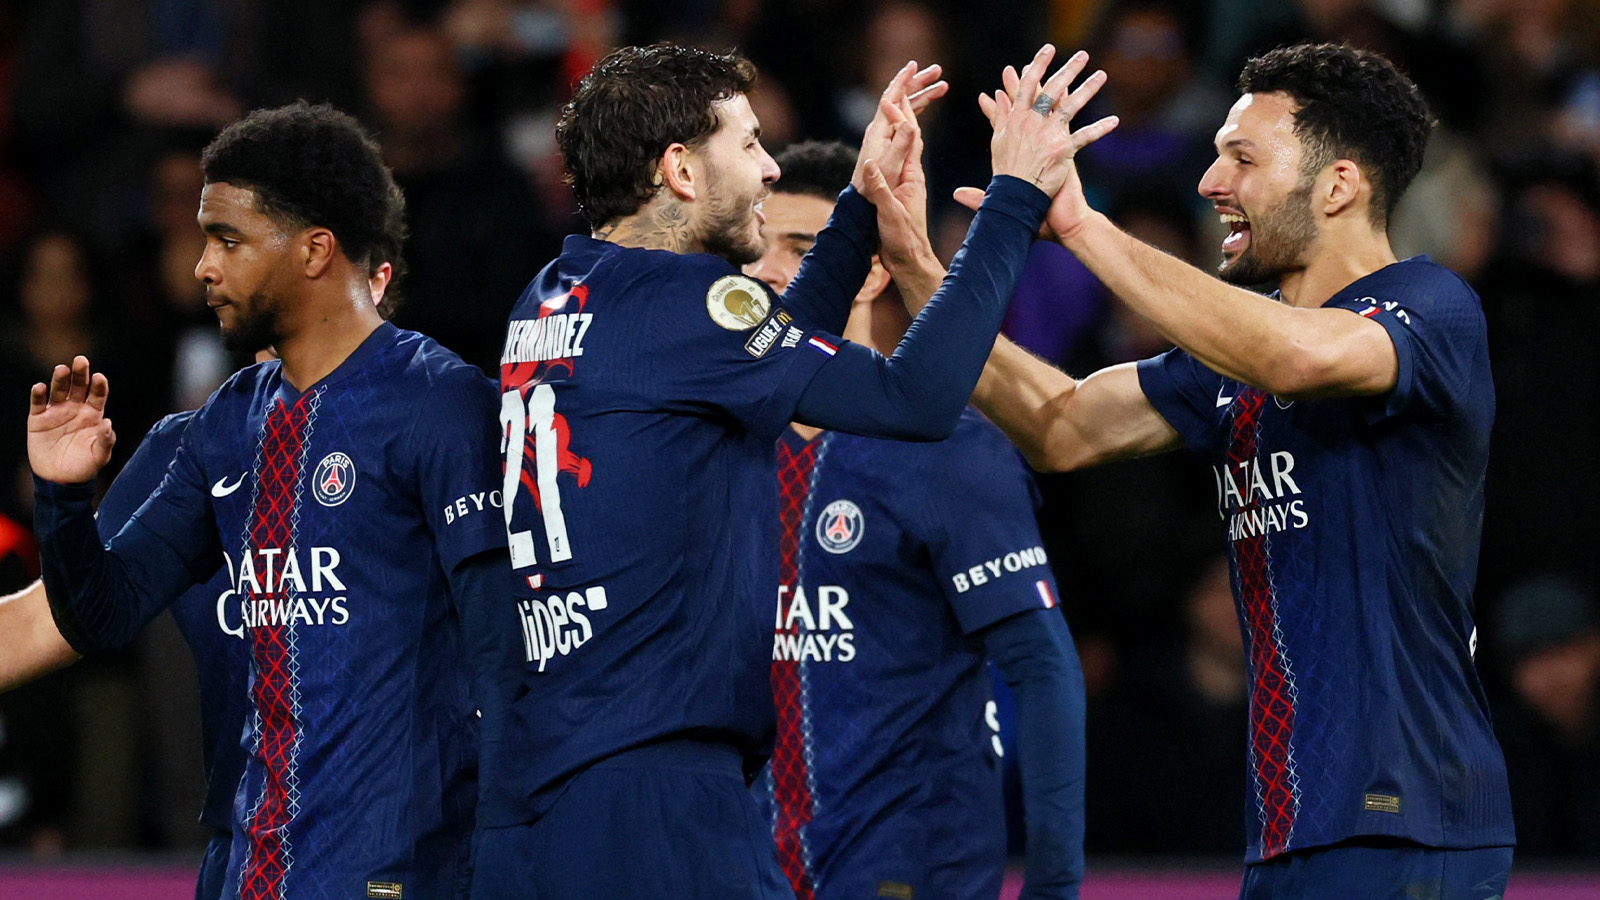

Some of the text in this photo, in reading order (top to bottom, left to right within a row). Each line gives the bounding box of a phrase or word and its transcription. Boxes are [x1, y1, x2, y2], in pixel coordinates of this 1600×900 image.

[781, 326, 804, 348] TEAM
[323, 455, 350, 468] PARIS
[499, 383, 573, 570] 21
[444, 490, 504, 525] BEYO
[1228, 500, 1309, 542] AIRWAYS
[952, 546, 1048, 593] BEYOND
[242, 597, 350, 628] AIRWAYS
[776, 585, 854, 630] TAR
[772, 633, 856, 662] RWAYS
